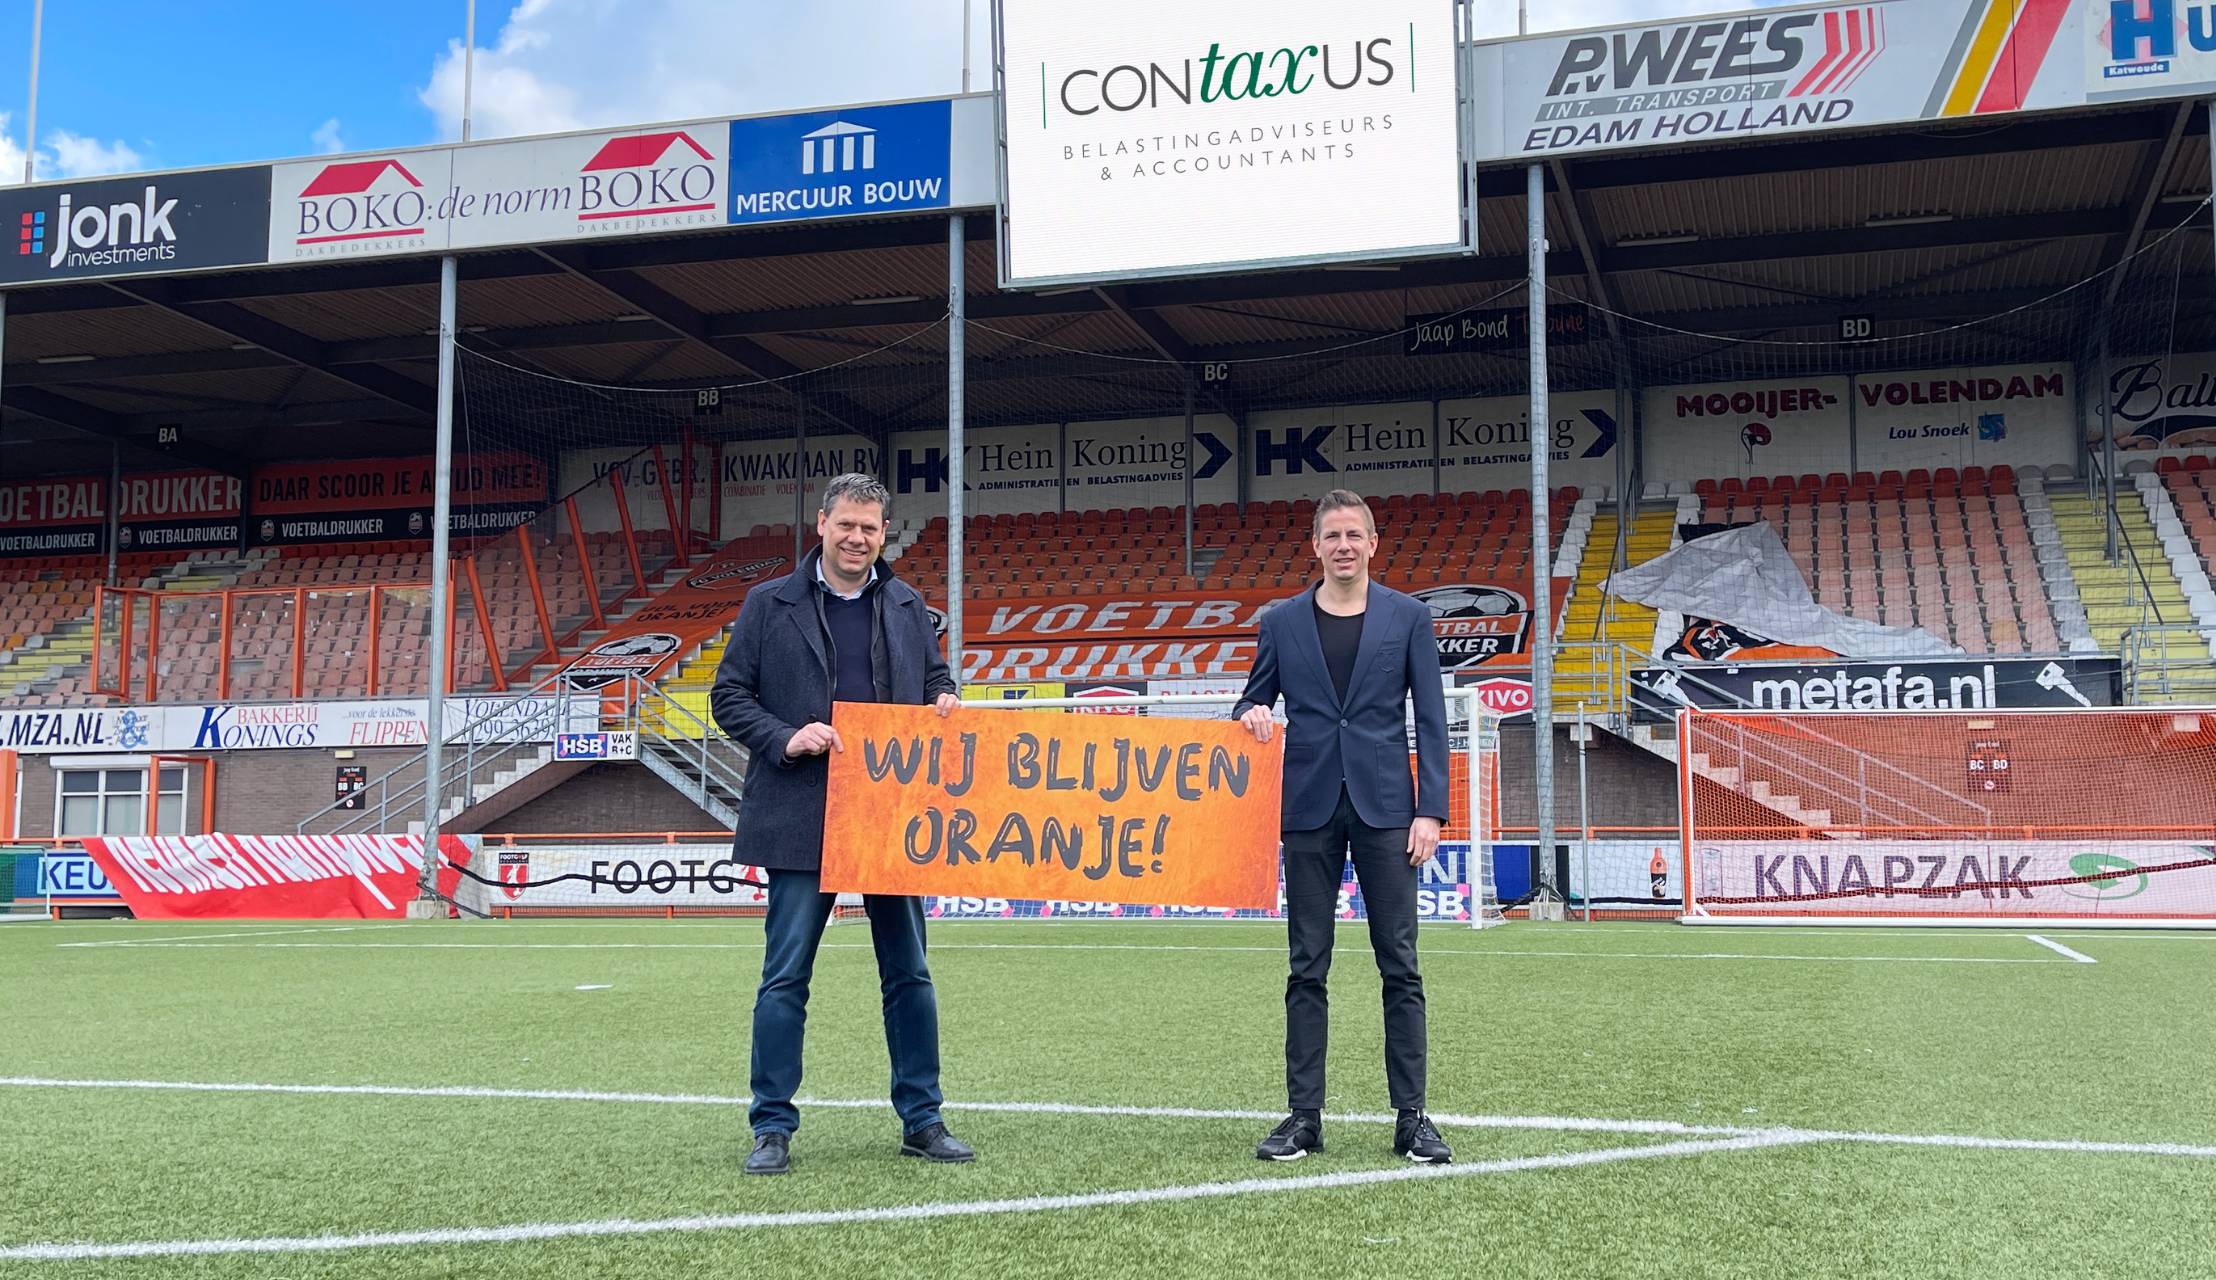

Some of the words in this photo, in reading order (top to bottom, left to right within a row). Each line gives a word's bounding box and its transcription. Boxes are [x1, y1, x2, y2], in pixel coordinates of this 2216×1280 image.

[2109, 63, 2165, 76] Katwoude
[1543, 100, 1595, 118] INT.
[1615, 82, 1775, 113] TRANSPORT
[1063, 114, 1394, 160] BELASTINGADVISEURS
[1524, 117, 1644, 152] EDAM
[1652, 99, 1855, 139] HOLLAND
[1101, 166, 1113, 181] &
[1133, 143, 1355, 178] ACCOUNTANTS
[485, 182, 571, 214] norm
[578, 164, 716, 211] BOKO
[736, 184, 854, 215] MERCUUR
[864, 176, 943, 204] BOUW
[50, 185, 178, 269] jonk
[576, 213, 717, 233] DAKBEDEKKERS
[67, 243, 176, 268] investments
[295, 238, 427, 258] DAKBEDEKKERS
[1410, 322, 1455, 352] Jaap
[1462, 314, 1509, 339] Bond
[1516, 312, 1585, 335] Tbune
[1842, 318, 1871, 337] BD
[1204, 363, 1228, 381] BC
[697, 389, 719, 407] BB
[1858, 373, 2065, 408] VOLENDAM
[157, 427, 178, 444] BA
[1344, 420, 1427, 453] Hein
[1888, 424, 1916, 440] Lou
[1921, 422, 1970, 439] Snoek
[724, 450, 844, 483] KWAKMAN
[854, 448, 883, 475] BV
[978, 441, 1054, 473] Hein
[1072, 435, 1187, 470] Koning
[1345, 459, 1435, 473] ADMINISTRATIE
[1440, 457, 1456, 468] EN
[1463, 450, 1570, 467] BELASTINGAVIES
[260, 476, 310, 503] DAAR
[318, 472, 385, 499] SCOOR
[392, 470, 412, 496] JE
[420, 468, 483, 494] AIJD
[491, 463, 542, 491] MEE!
[724, 485, 766, 498] COMBINATIE
[776, 482, 815, 495] VOLENAM
[978, 479, 1060, 491] ADMINISTRATIE
[1066, 477, 1080, 487] EN
[1087, 471, 1184, 485] BELASTINGADVIES
[282, 519, 384, 538] VOETBALDRUKKER
[430, 511, 537, 531] VETBALDRUKKER
[139, 526, 239, 545] VOETBALDRUKKER
[711, 557, 787, 580] VOLENDAM
[1433, 620, 1503, 635] TBAL
[1752, 663, 1996, 710] metafa.nl
[237, 706, 319, 725] BAKKERIJ
[367, 707, 378, 718] de
[189, 705, 320, 749] KONINGS
[611, 734, 632, 743] VAK
[562, 739, 604, 754] HSB
[863, 731, 978, 797] WIJ
[1007, 732, 1251, 802] BLIJVEN
[1970, 759, 1985, 770] BC
[1993, 759, 2008, 770] BD
[904, 806, 1171, 881] ORANJE!
[41, 861, 115, 890] KEU
[1754, 854, 2034, 901] KNAPZAK
